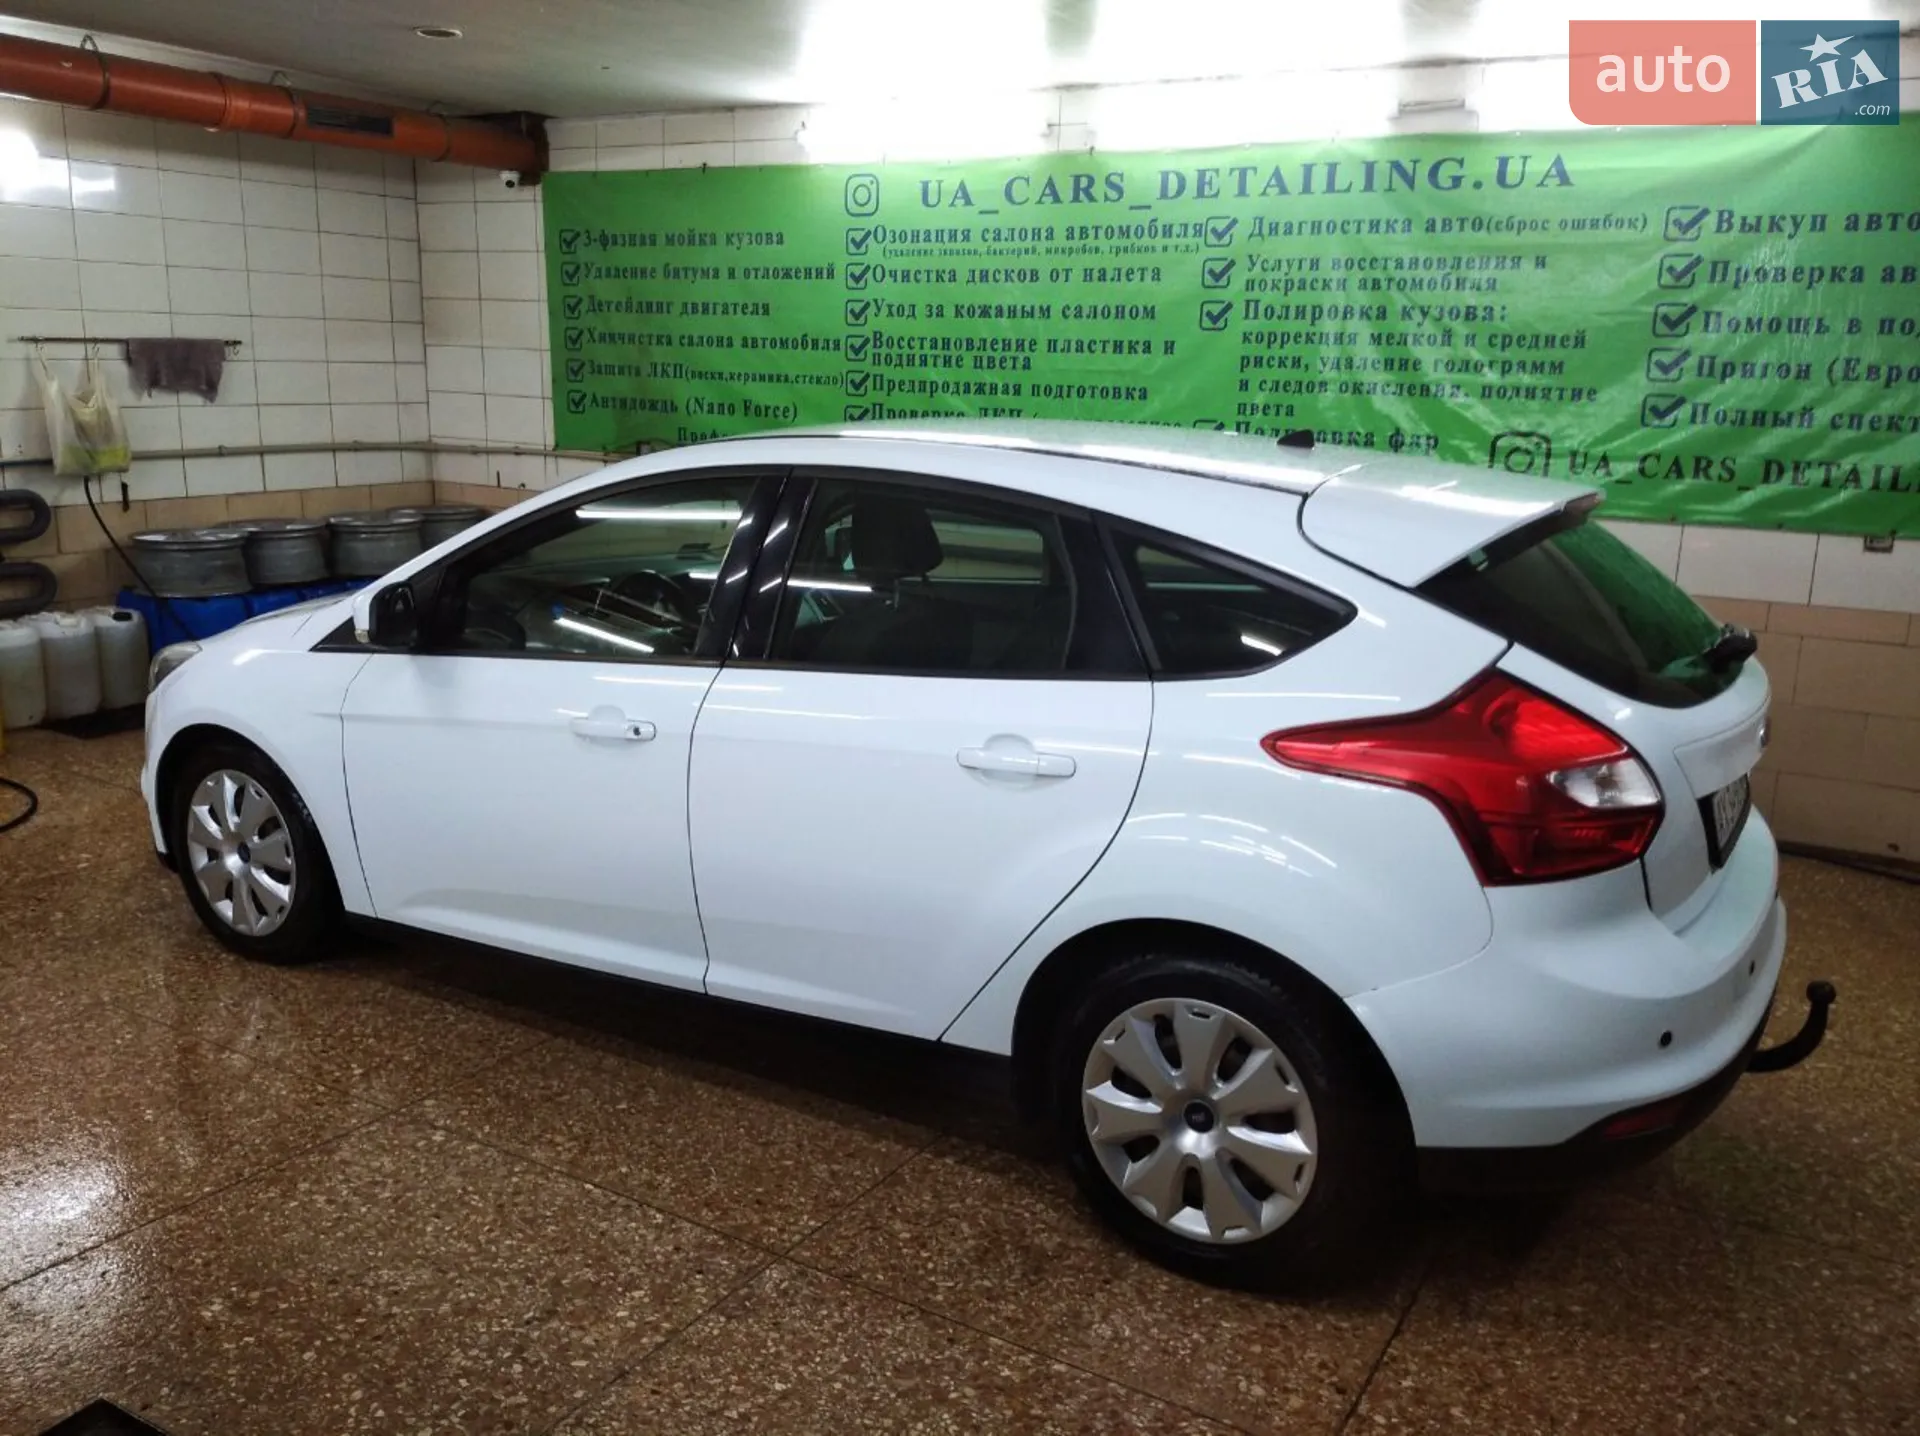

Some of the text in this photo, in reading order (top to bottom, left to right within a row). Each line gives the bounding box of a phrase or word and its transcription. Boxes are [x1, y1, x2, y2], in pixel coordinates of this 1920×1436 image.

[919, 153, 1575, 214] UA_CARS_DETAILING.UA
[872, 217, 1204, 246] Озонация салона автомобиля
[1248, 215, 1413, 241] Диагностика
[1558, 211, 1648, 233] ошибок)
[1714, 209, 1827, 239] Выкуп
[665, 229, 717, 247] мойка
[725, 230, 784, 250] кузова
[583, 262, 836, 284] Удаление битума и отложений
[872, 264, 1162, 287] Очистка дисков от налета
[1246, 253, 1548, 276] Услуги восстановления и
[1708, 259, 1865, 289] Проверка
[1244, 273, 1498, 296] покраски автомобиля
[586, 295, 771, 317] Детейлинг двигателя
[872, 298, 1156, 321] Уход за кожаным салоном
[1243, 300, 1508, 327] Полировка кузова:
[586, 323, 842, 352] Химчистка салона автомобиля
[1702, 311, 1830, 338] Помощь
[1845, 316, 1862, 335] в
[871, 330, 1176, 356] Восстановление пластика и
[1241, 328, 1588, 354] коррекция мелкой и средней
[586, 360, 642, 378] Защита
[871, 353, 1032, 372] поднятие цвета
[1239, 352, 1565, 379] риски, удаление голограмм
[1696, 355, 1812, 384] Пригон
[871, 374, 1149, 401] Предпродажная подготовка
[1238, 378, 1250, 394] и
[1258, 378, 1329, 395] следов
[1481, 385, 1598, 404] поднятие
[587, 392, 798, 423] Антидождь (Nano Force)
[1237, 401, 1295, 419] цвета
[1689, 402, 1815, 430] Полный
